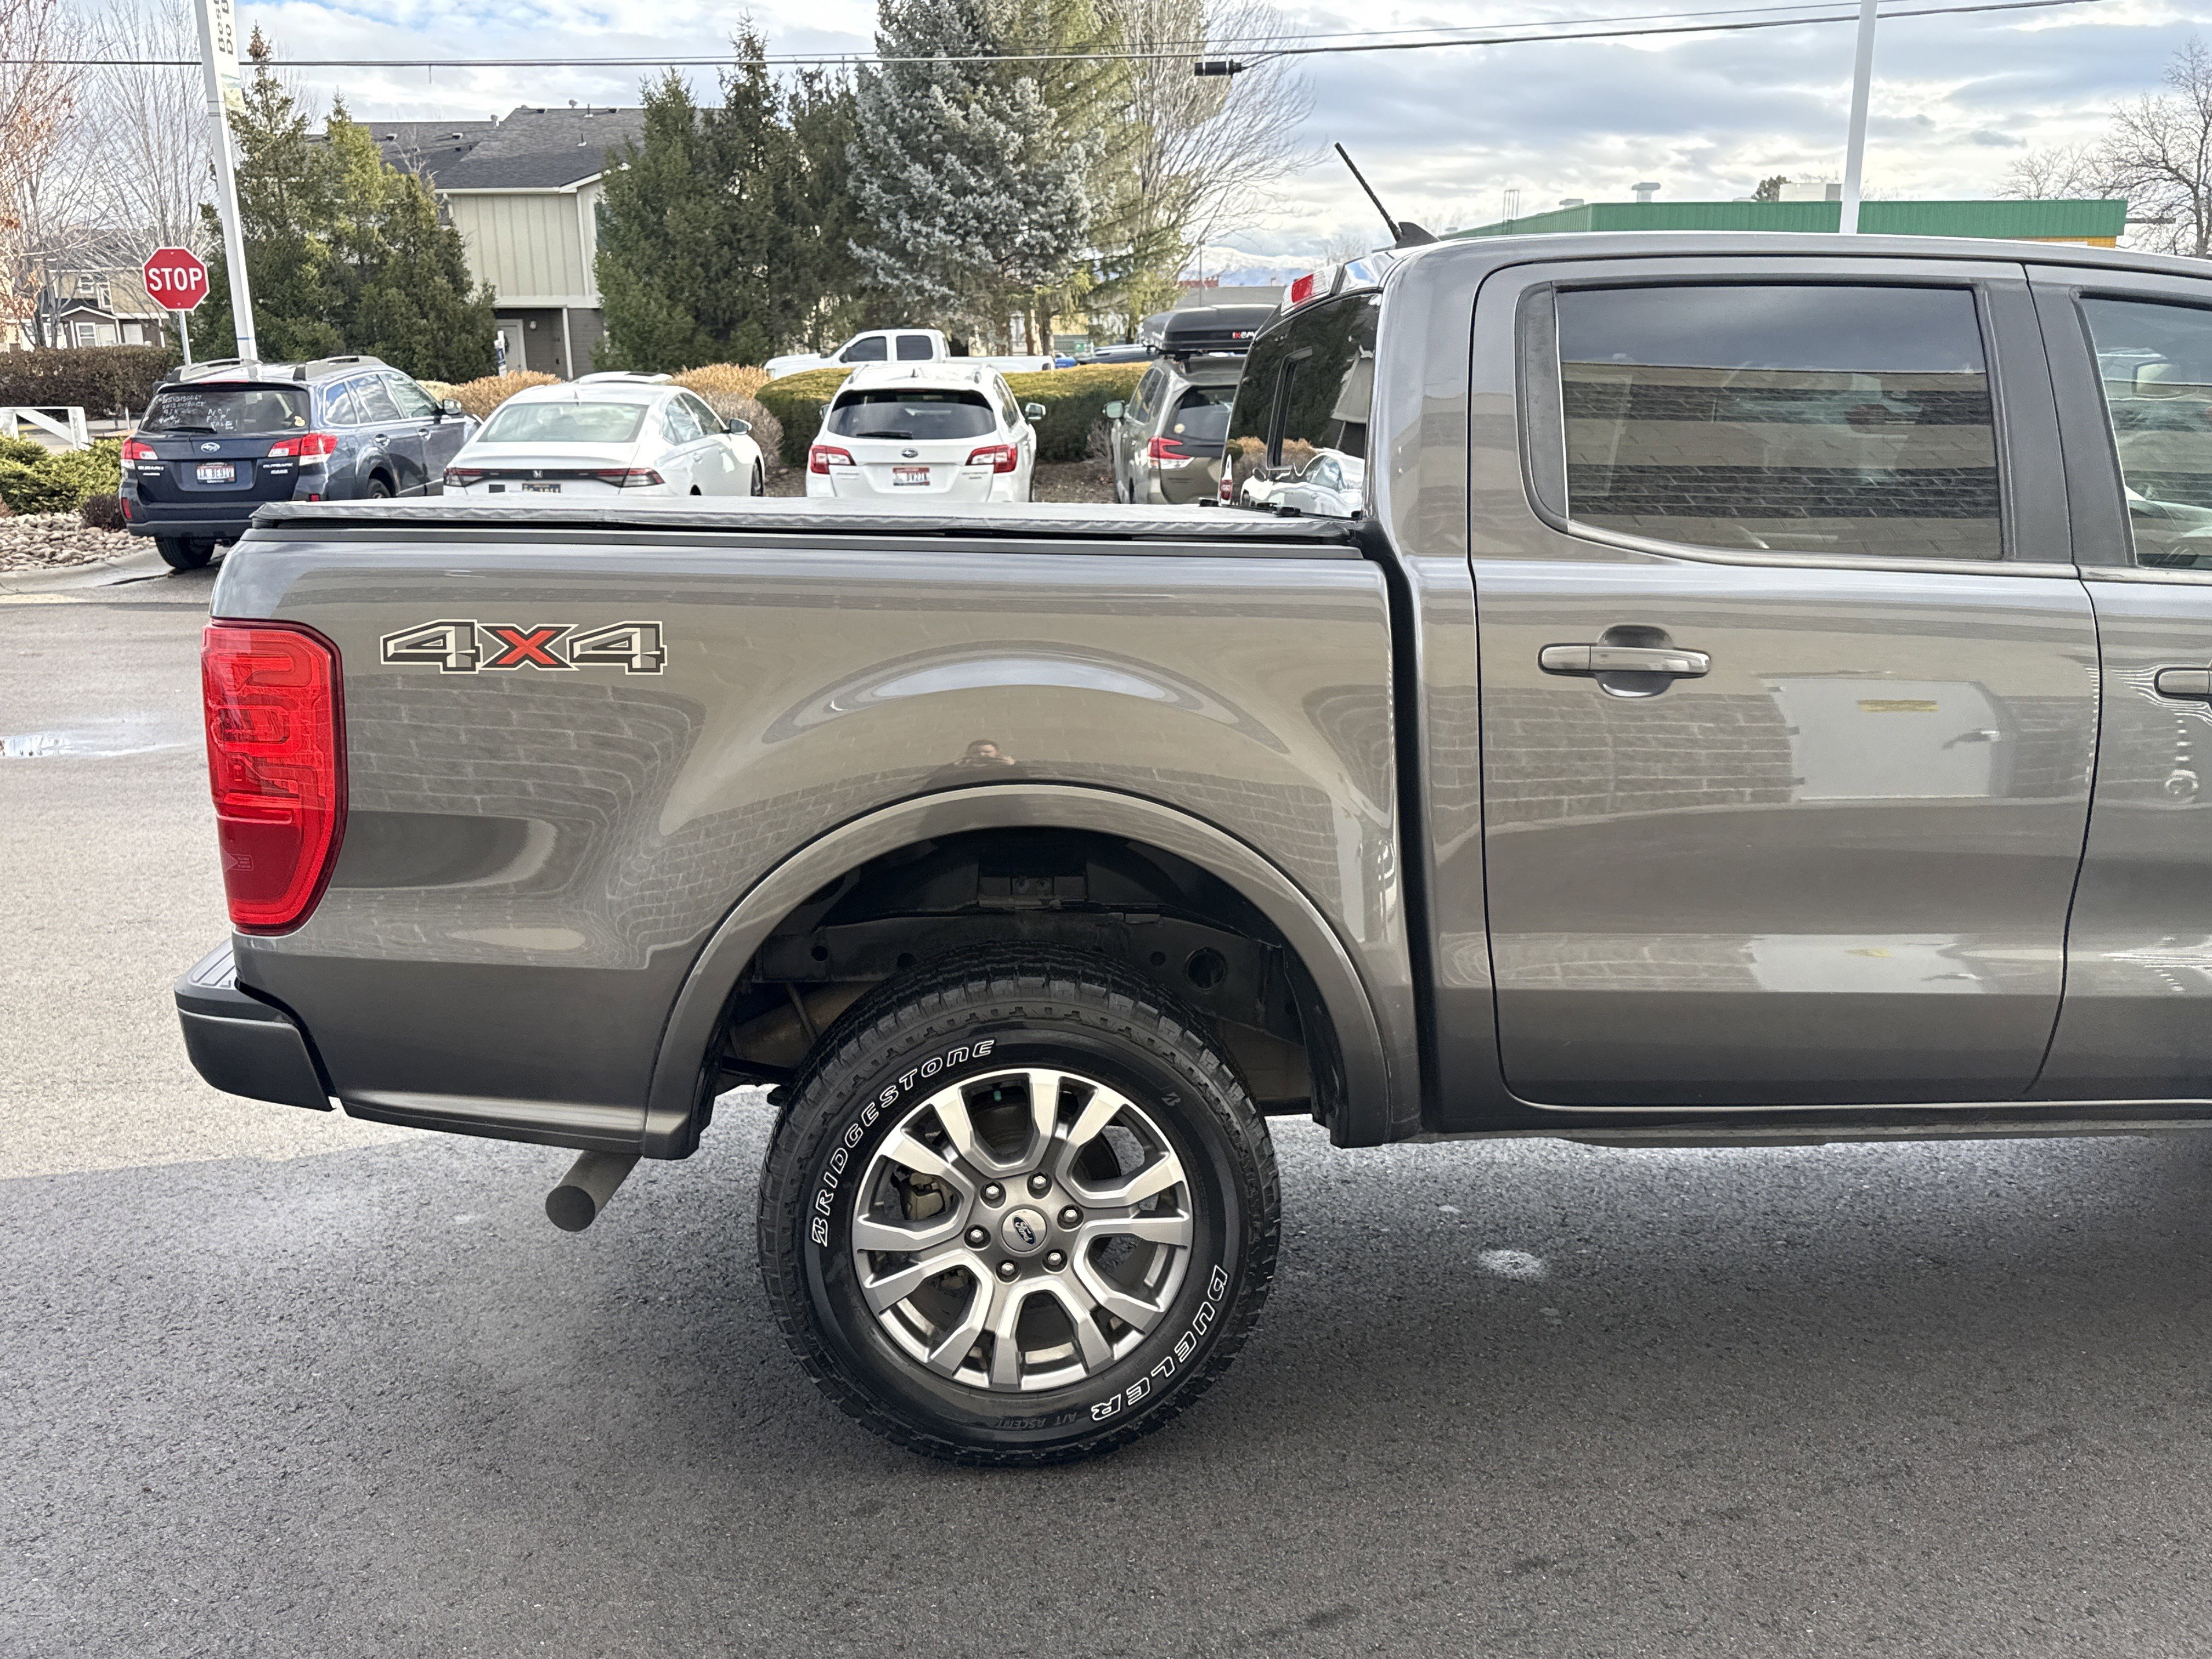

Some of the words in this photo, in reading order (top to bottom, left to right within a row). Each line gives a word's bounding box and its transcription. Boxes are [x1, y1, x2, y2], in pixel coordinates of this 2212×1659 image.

[148, 267, 202, 291] STOP
[206, 414, 227, 423] FOR
[208, 408, 230, 416] NOT
[381, 619, 668, 675] 4X4
[811, 1040, 995, 1247] BRIDGESTONE
[1014, 1221, 1032, 1242] Ford
[1091, 1265, 1228, 1421] DUELER
